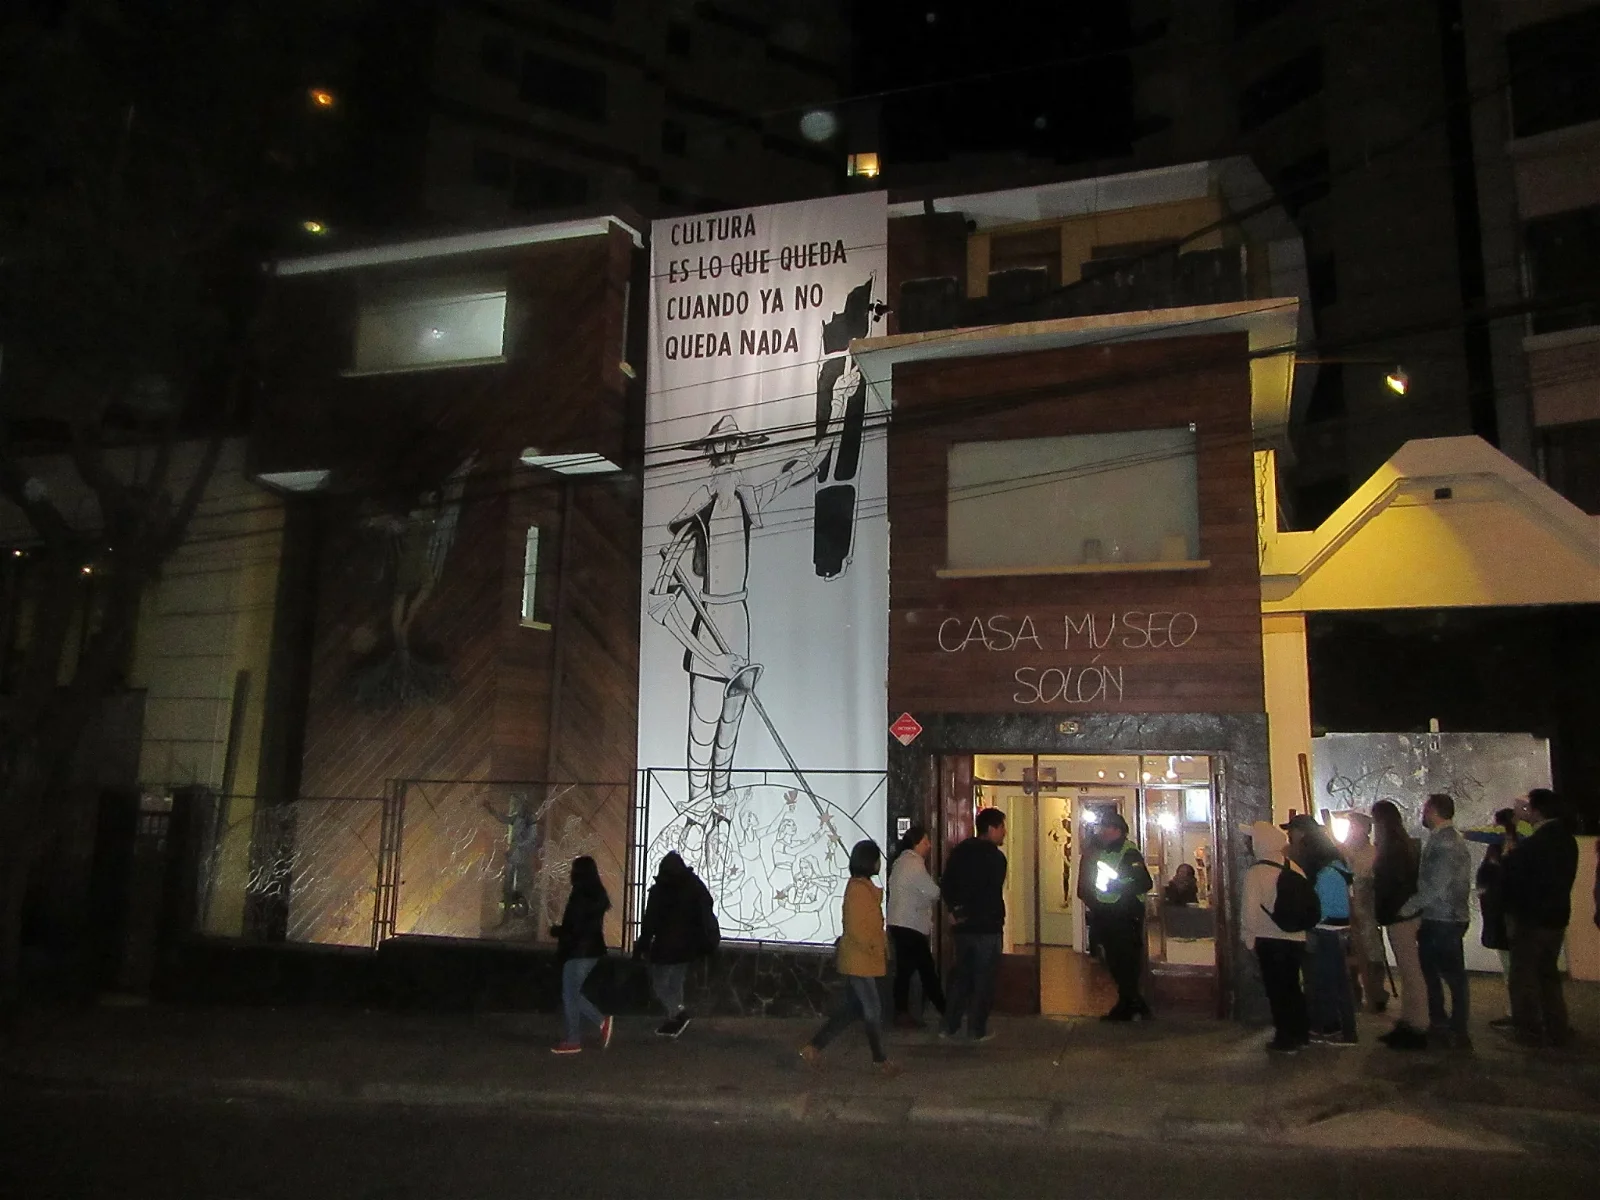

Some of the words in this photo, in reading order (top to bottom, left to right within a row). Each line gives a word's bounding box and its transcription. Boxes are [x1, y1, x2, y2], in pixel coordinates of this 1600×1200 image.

[671, 213, 756, 246] CULTURA
[669, 258, 690, 284] ES
[699, 255, 722, 280] LO
[731, 249, 770, 277] QUE
[780, 239, 847, 271] QUEDA
[667, 290, 749, 321] CUANDO
[759, 288, 784, 314] YA
[795, 283, 824, 310] NO
[665, 331, 732, 360] QUEDA
[740, 327, 799, 356] NADA
[938, 615, 1043, 652] CASA
[1064, 611, 1198, 650] MUSEO
[1013, 654, 1123, 704] SOLÓN
